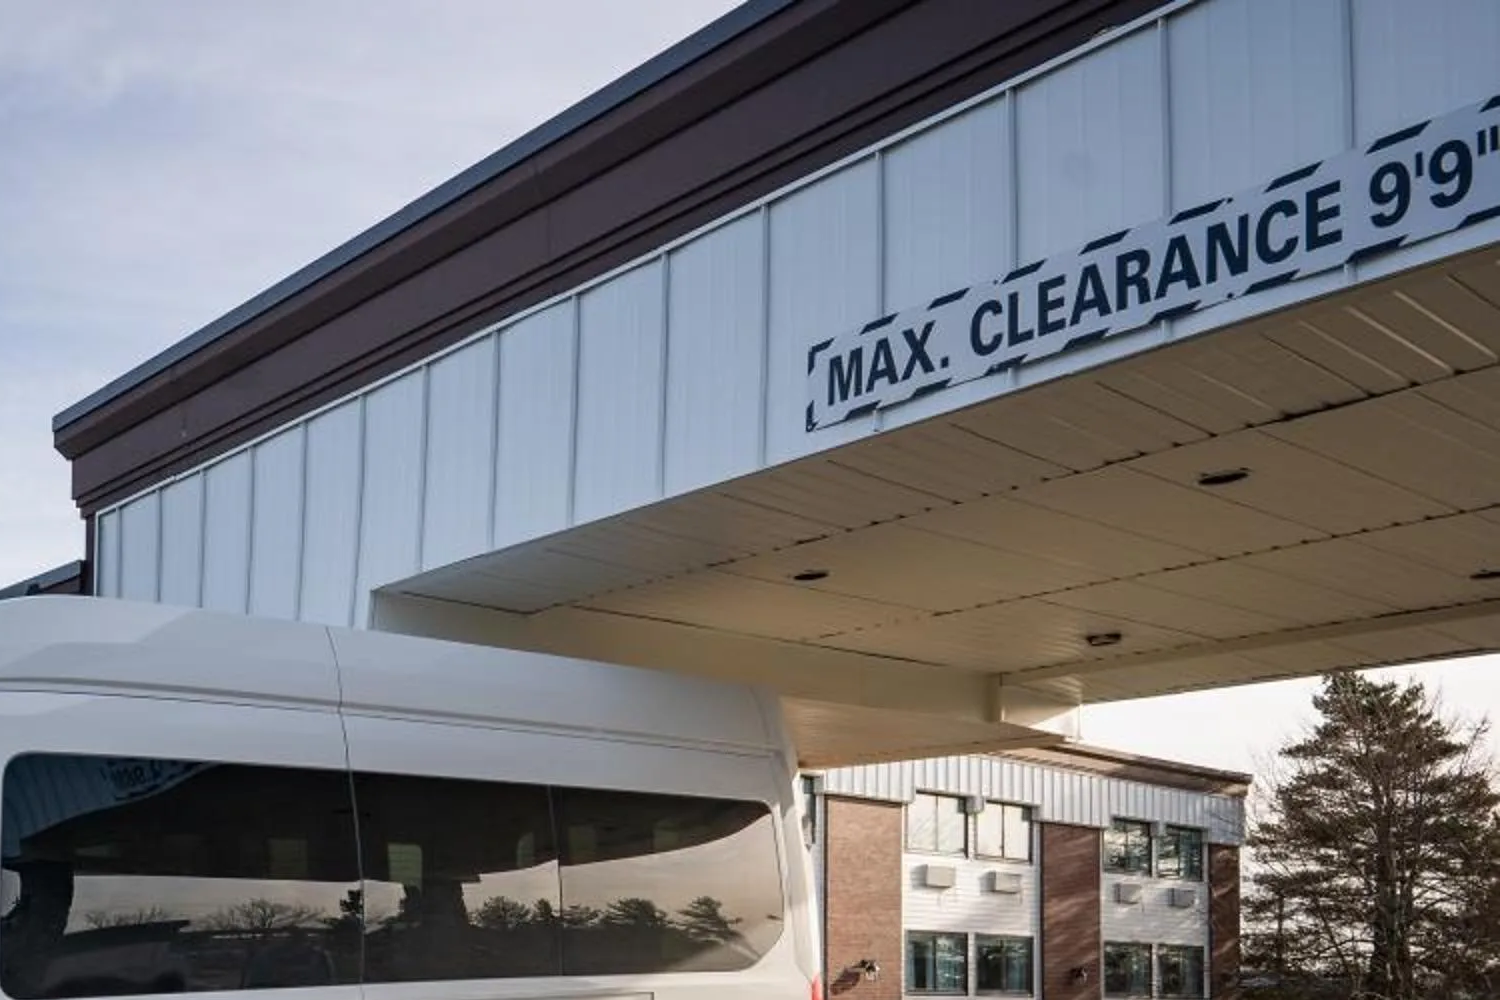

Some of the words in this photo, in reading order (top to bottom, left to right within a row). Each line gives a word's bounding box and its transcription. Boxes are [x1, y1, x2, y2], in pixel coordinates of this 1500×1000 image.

[827, 319, 950, 407] MAX.
[969, 180, 1344, 357] CLEARANCE
[1369, 126, 1499, 229] 9'9"
